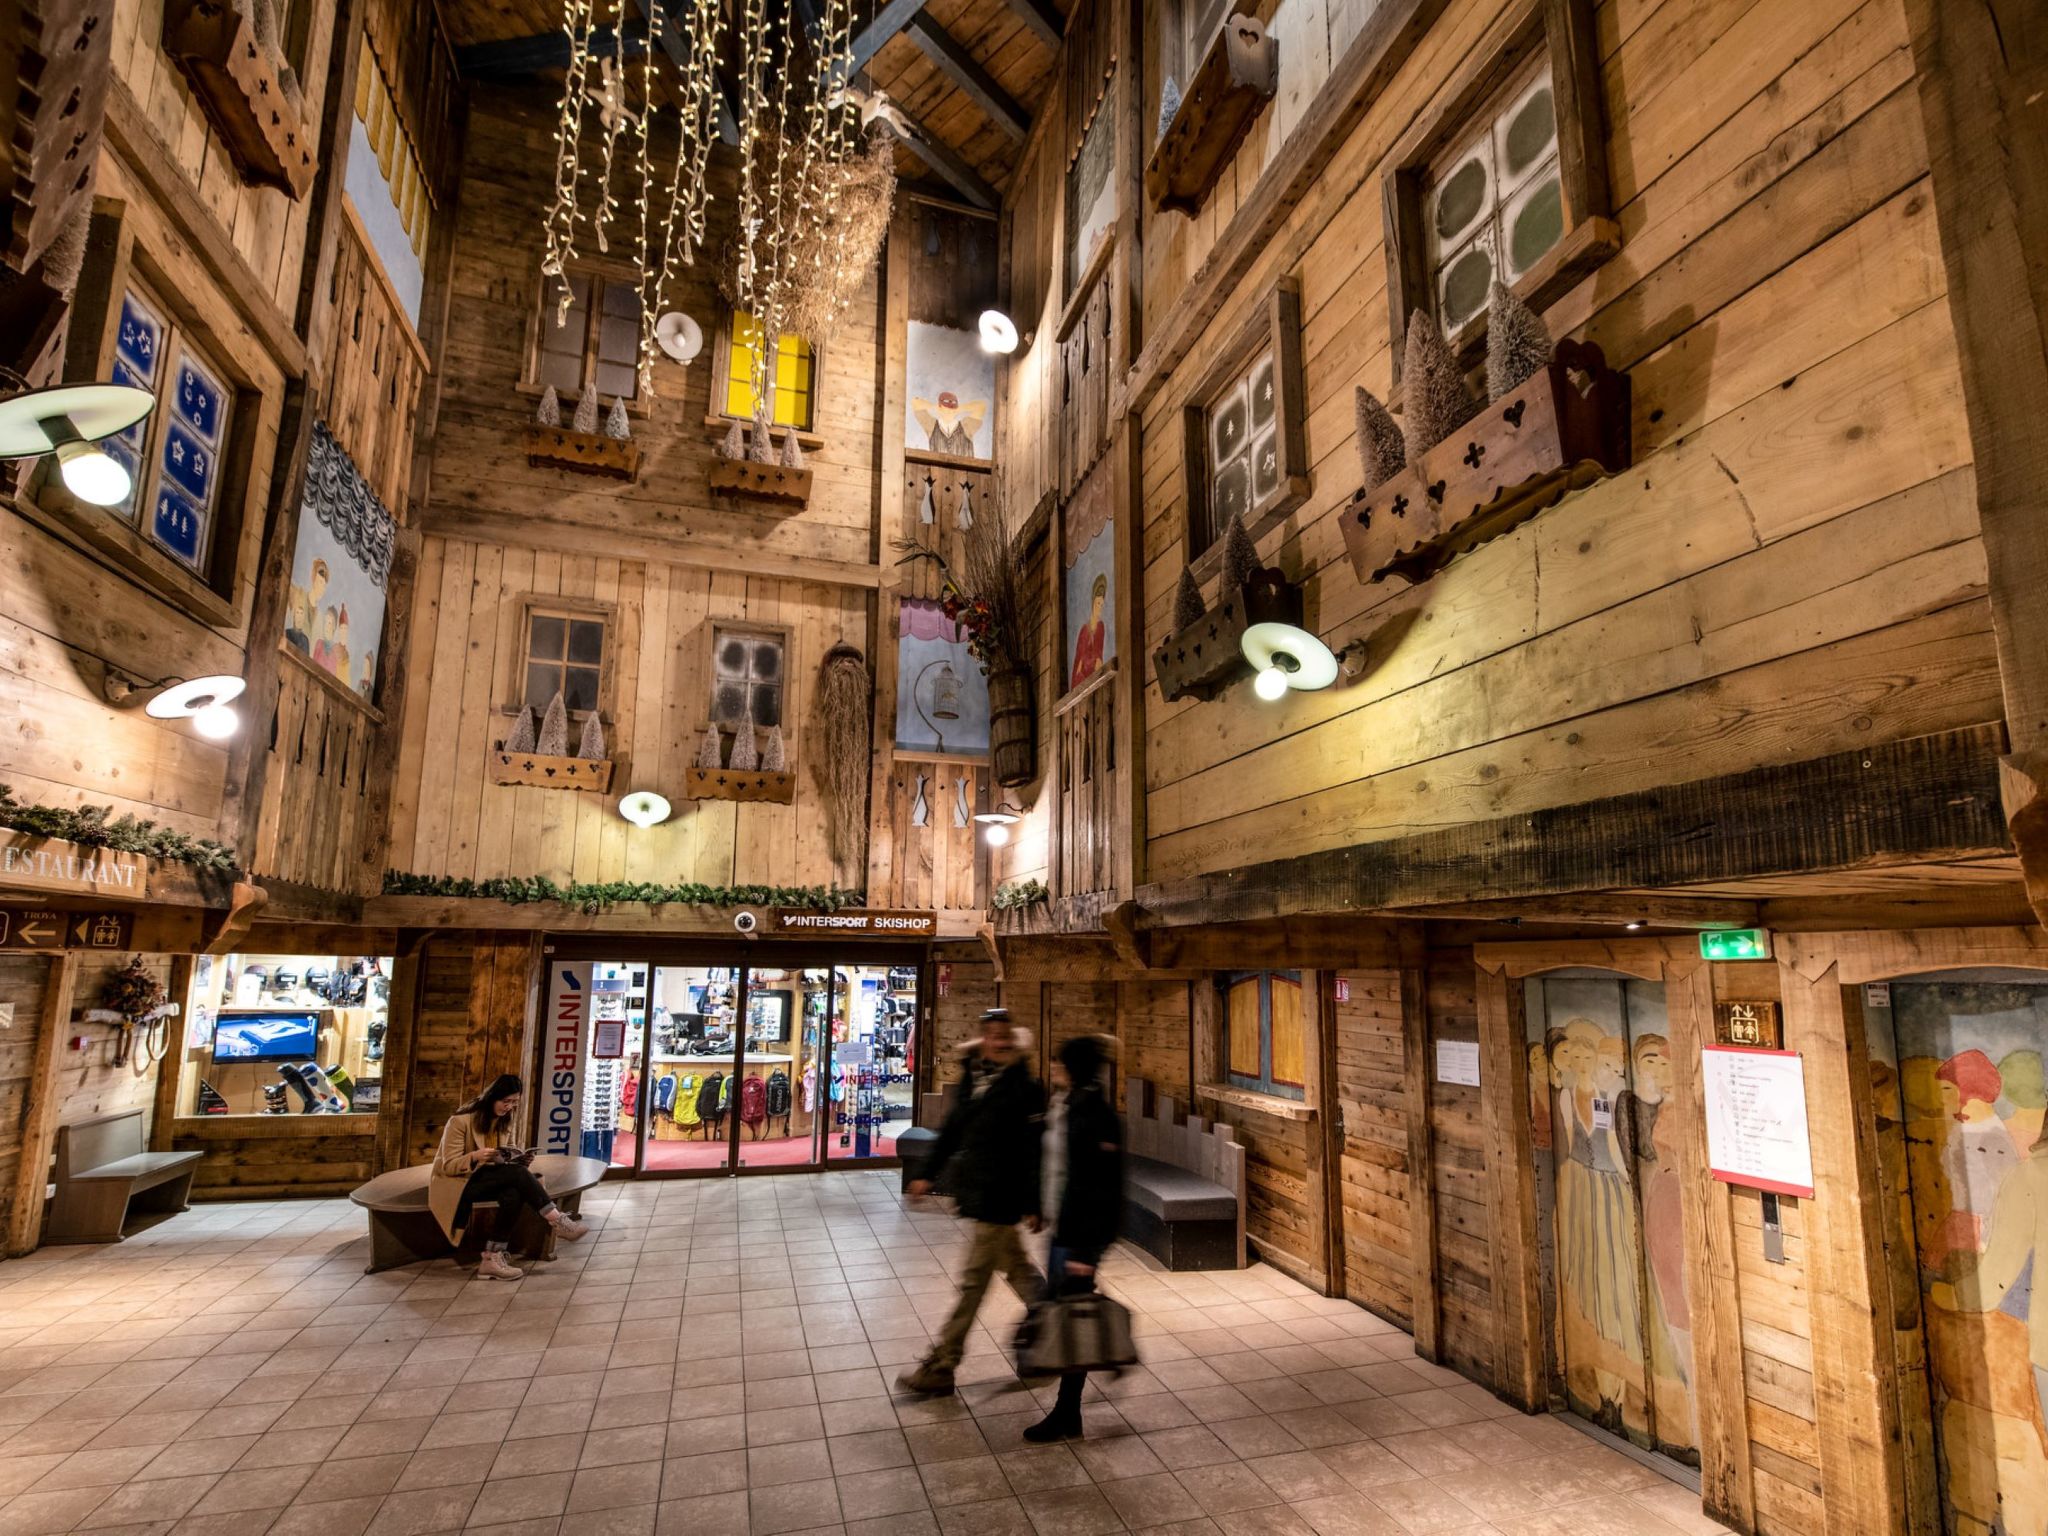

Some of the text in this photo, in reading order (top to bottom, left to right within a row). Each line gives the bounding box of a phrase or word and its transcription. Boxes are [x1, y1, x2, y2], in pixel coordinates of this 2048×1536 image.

[0, 846, 137, 888] ESTAURANT
[797, 915, 931, 929] INTERSPORT SKISHOP
[547, 993, 582, 1157] INTERSPORT
[845, 1074, 912, 1084] INTERSPORT
